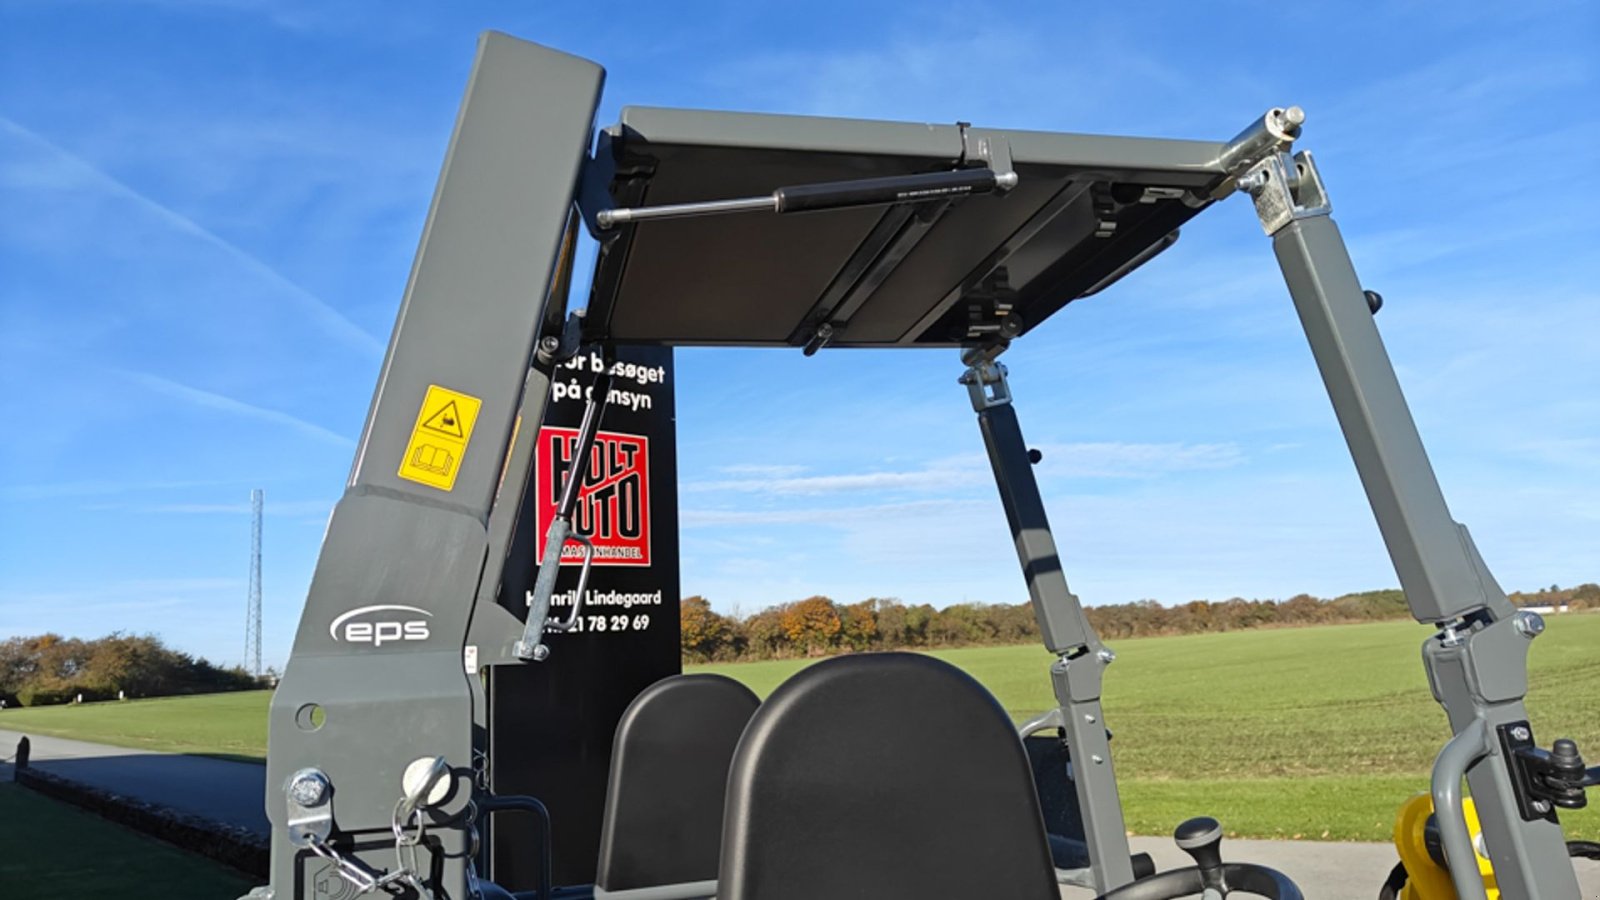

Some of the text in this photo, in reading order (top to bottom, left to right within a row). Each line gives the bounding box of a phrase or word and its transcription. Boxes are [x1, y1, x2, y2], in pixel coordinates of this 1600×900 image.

[556, 355, 587, 371] or
[553, 378, 581, 403] på
[546, 472, 641, 538] UTO
[585, 589, 662, 609] Lindegaard
[345, 620, 430, 647] eps
[587, 615, 607, 632] 78
[610, 615, 629, 631] 29
[632, 614, 650, 631] 69
